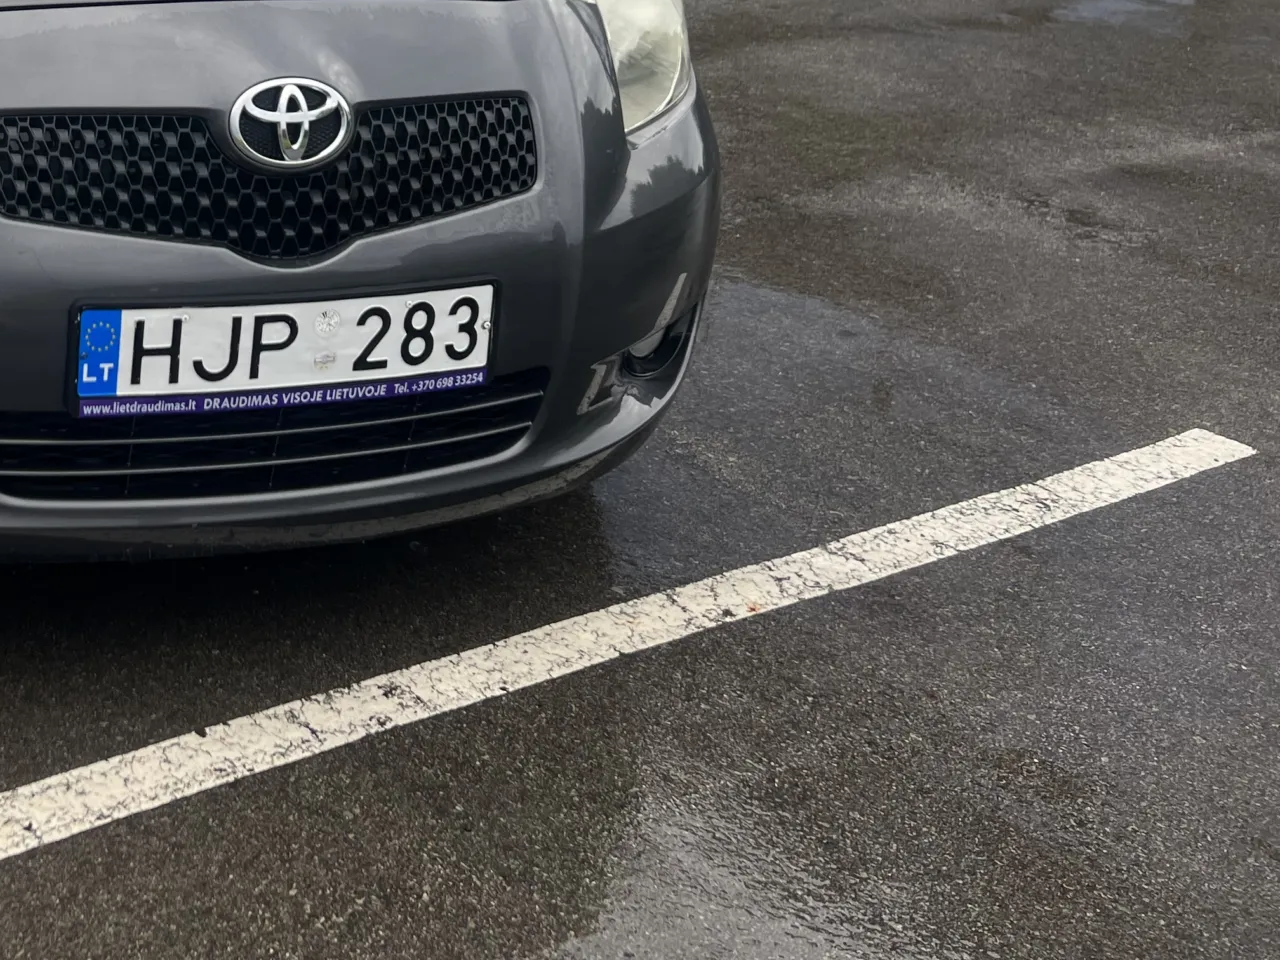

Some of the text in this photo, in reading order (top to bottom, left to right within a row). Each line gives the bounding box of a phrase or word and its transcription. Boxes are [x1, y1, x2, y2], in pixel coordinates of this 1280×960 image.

[130, 296, 480, 385] HJP 283
[82, 362, 114, 383] LT
[83, 372, 483, 415] www.lietdraudimas.lt DRAUDIMAS VISOJE LIETUVOJE Tel. +370 698 33254
